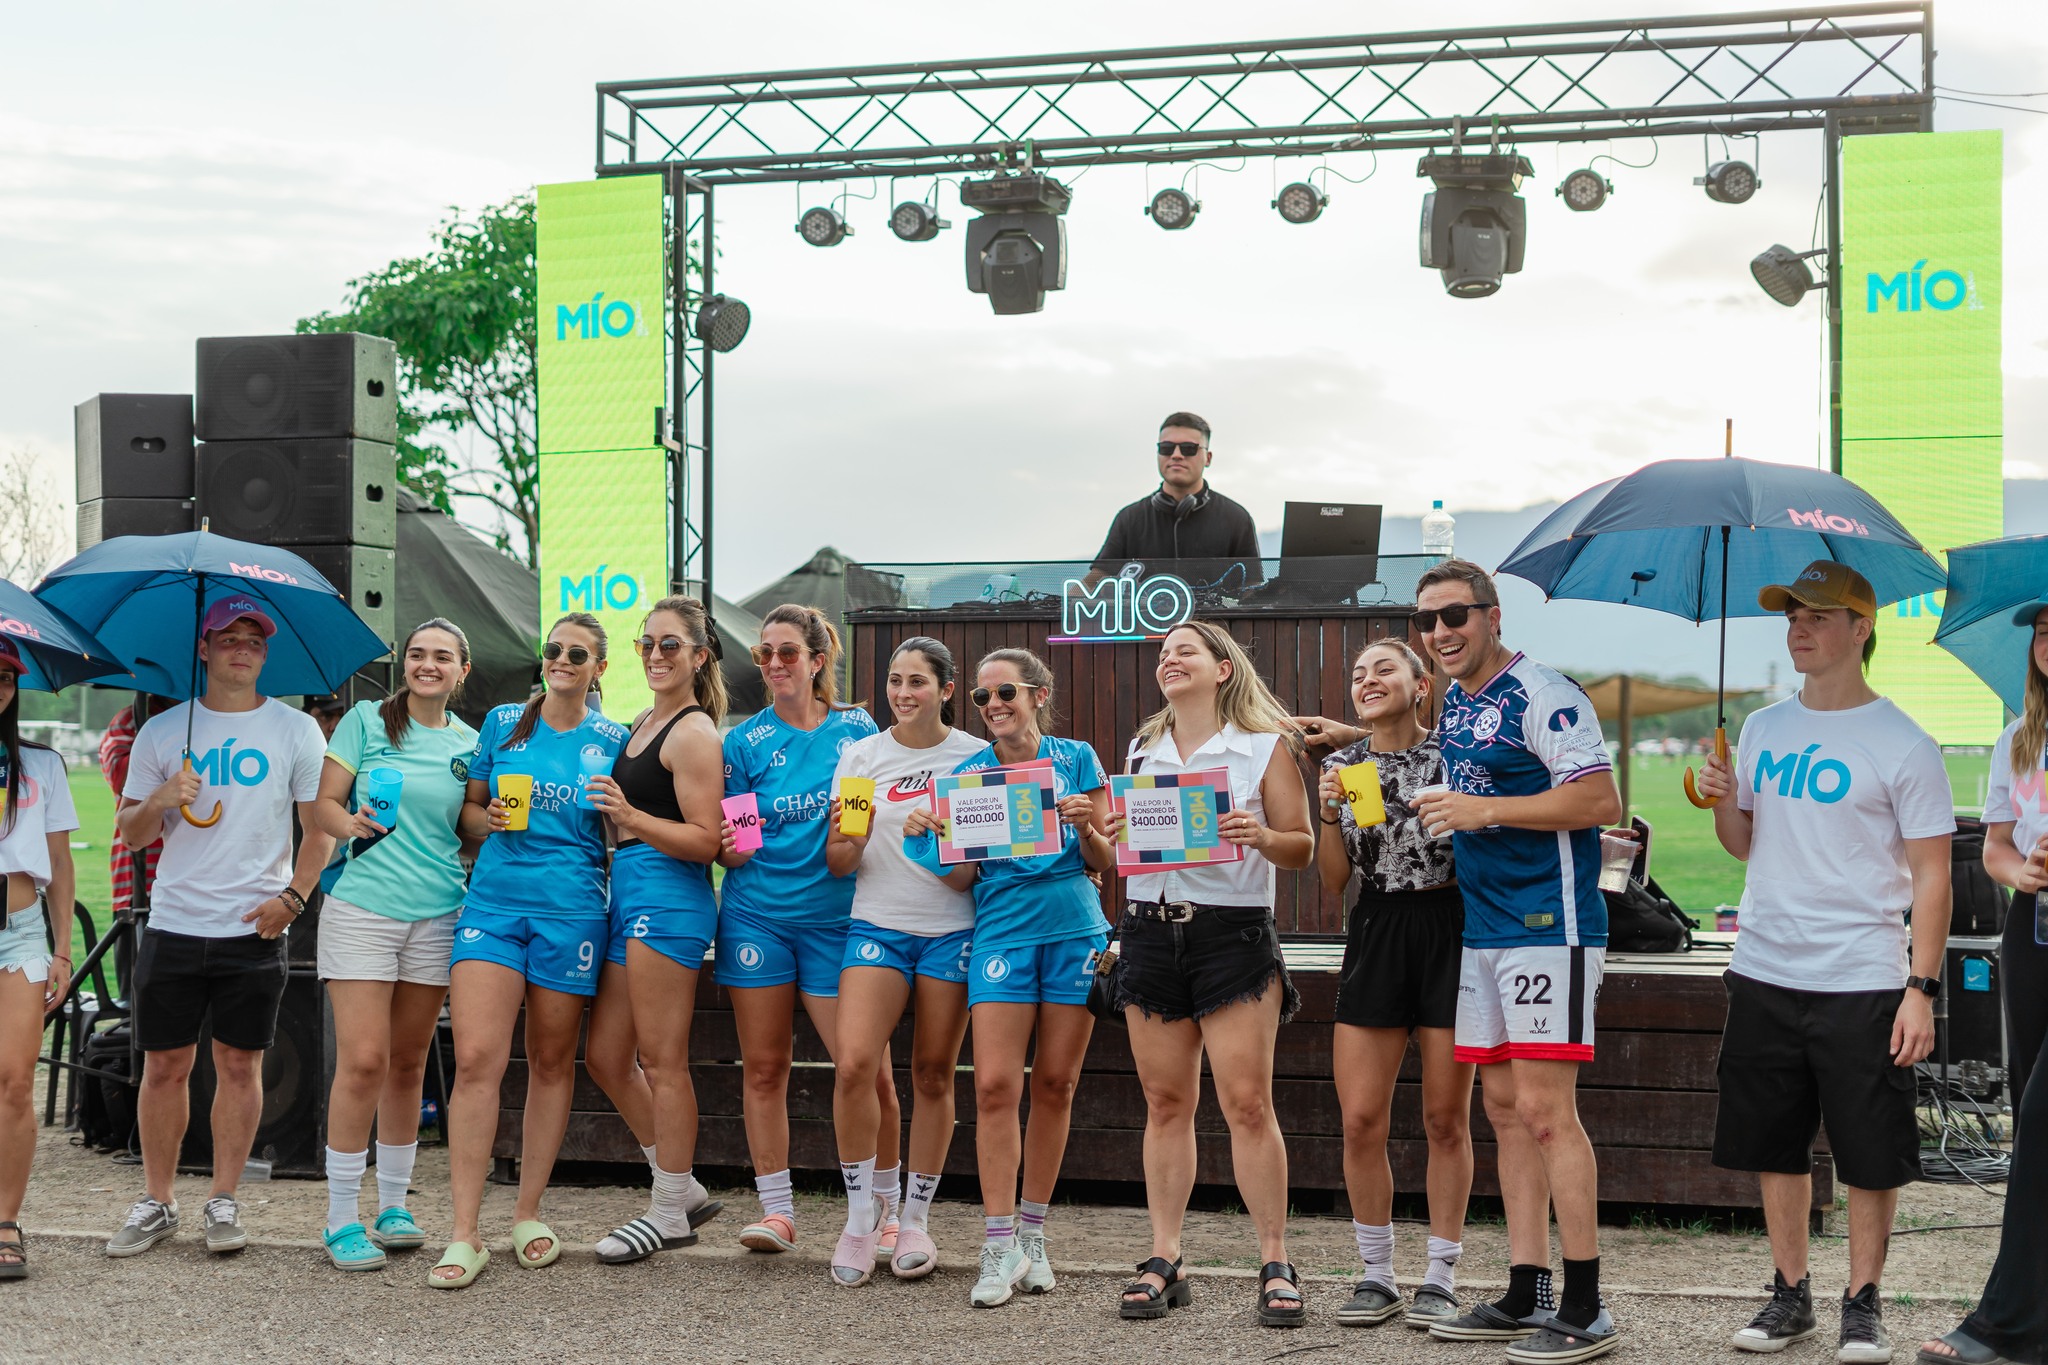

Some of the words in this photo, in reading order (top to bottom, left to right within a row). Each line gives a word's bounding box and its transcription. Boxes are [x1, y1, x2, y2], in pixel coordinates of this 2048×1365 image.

[1866, 259, 1967, 313] MÍO
[557, 291, 635, 341] MÍO
[1787, 508, 1854, 533] MÍO
[229, 562, 286, 582] MÍO
[560, 564, 638, 612] MÍO
[182, 737, 270, 786] MÍO
[898, 770, 932, 790] nik
[1753, 743, 1852, 805] MÍO
[531, 797, 560, 812] CAR
[773, 790, 828, 813] CHAS
[844, 795, 869, 811] MÍO
[956, 804, 994, 814] SPONSOREO
[957, 798, 974, 806] VALE
[974, 797, 989, 805] POR
[1015, 788, 1037, 825] MÍO
[1131, 807, 1167, 815] SPONSOREO
[1188, 791, 1211, 829] MÍO
[732, 812, 757, 830] MÍO
[955, 811, 1005, 825] $400.000
[1131, 815, 1178, 827] $400.000
[633, 915, 650, 937] 6
[577, 941, 594, 971] 9
[1514, 974, 1552, 1005] 22
